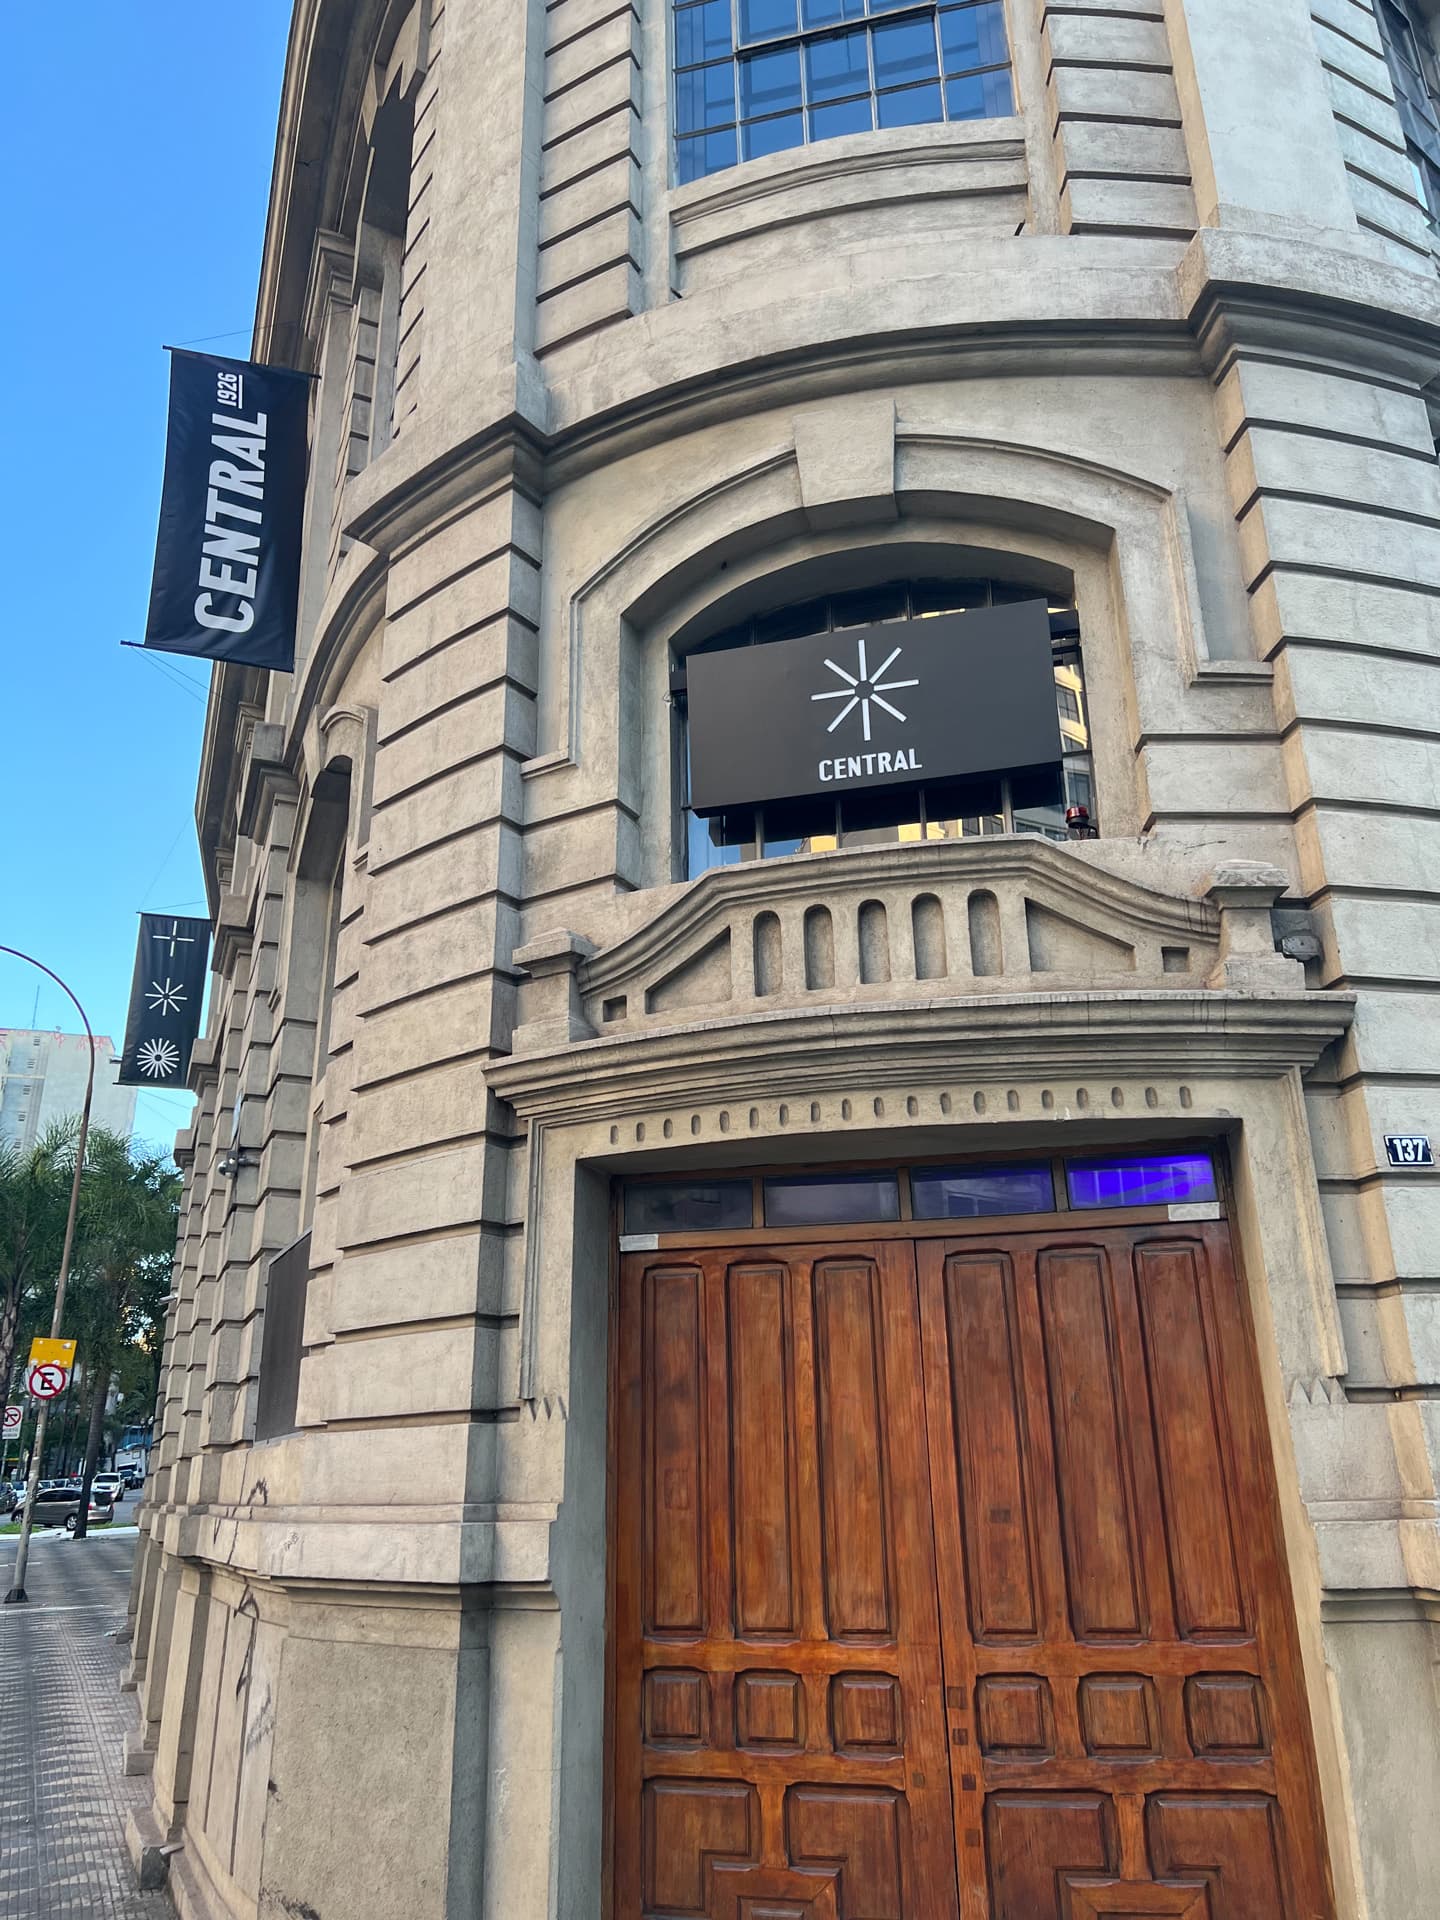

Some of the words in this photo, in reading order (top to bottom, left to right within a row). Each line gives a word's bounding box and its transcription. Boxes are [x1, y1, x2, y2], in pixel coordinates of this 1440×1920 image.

[217, 372, 238, 407] 1926
[194, 412, 267, 633] CENTRAL
[818, 748, 923, 782] CENTRAL
[1392, 1138, 1423, 1161] 137
[40, 1372, 55, 1390] E
